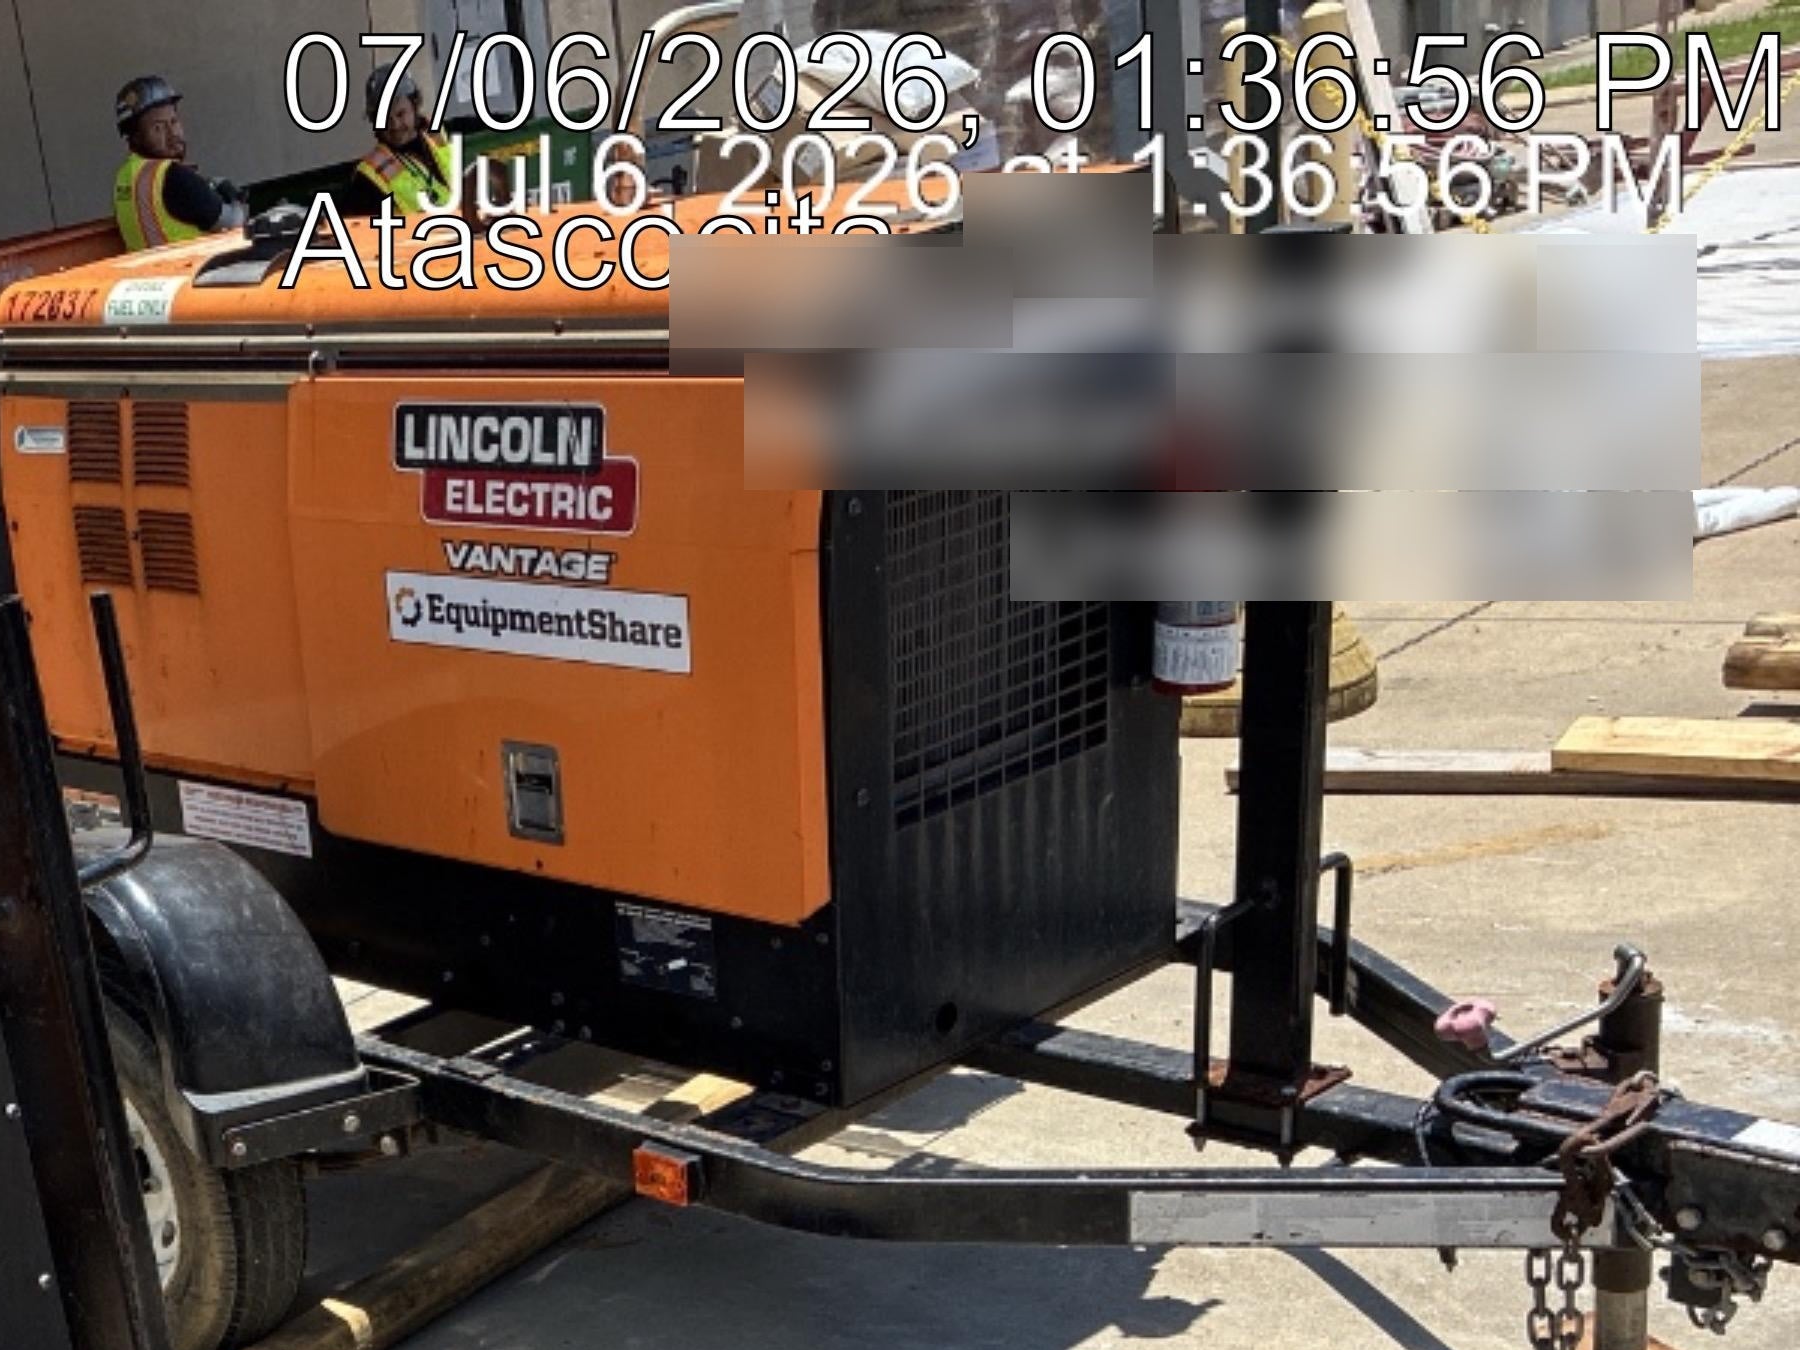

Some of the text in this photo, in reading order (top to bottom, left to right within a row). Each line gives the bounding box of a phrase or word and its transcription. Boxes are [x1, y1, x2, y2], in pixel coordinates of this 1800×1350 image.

[403, 413, 593, 466] LINCOLN
[445, 478, 613, 521] ELECTRIC
[443, 541, 611, 582] VANTAGE
[426, 592, 683, 649] EquipmentShare
